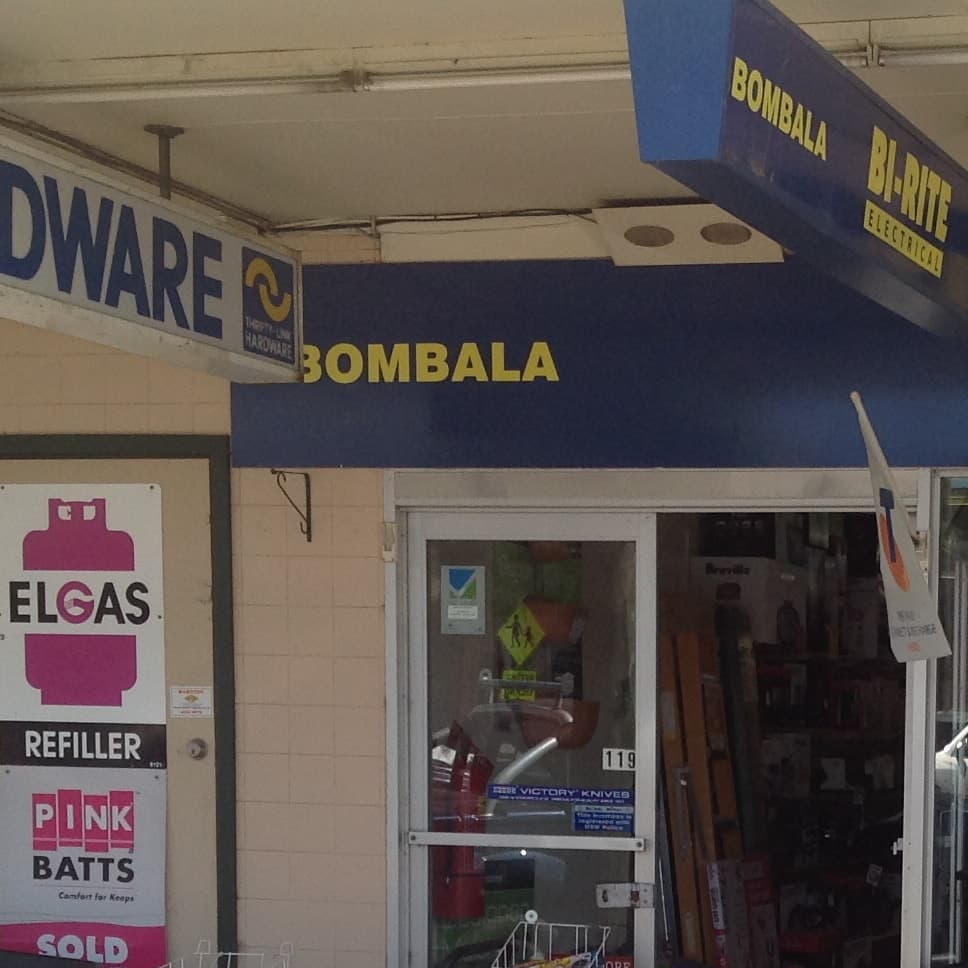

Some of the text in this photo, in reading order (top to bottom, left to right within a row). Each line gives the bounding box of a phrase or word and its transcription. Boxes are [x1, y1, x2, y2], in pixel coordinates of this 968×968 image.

[730, 57, 828, 160] BOMBALA
[867, 126, 951, 243] BI-RITE
[866, 203, 942, 272] ELECTRICAL
[244, 331, 293, 361] HARDWARE
[303, 342, 560, 385] BOMBALA
[9, 580, 151, 625] ELGAS
[25, 730, 142, 761] REFILLER
[606, 751, 636, 769] 119
[519, 787, 577, 797] VICTORY
[581, 790, 630, 799] KNIVES
[35, 803, 133, 832] PINK
[33, 855, 135, 884] BATTS
[58, 891, 135, 904] Comfort for Keeps
[37, 934, 129, 965] SOLD
